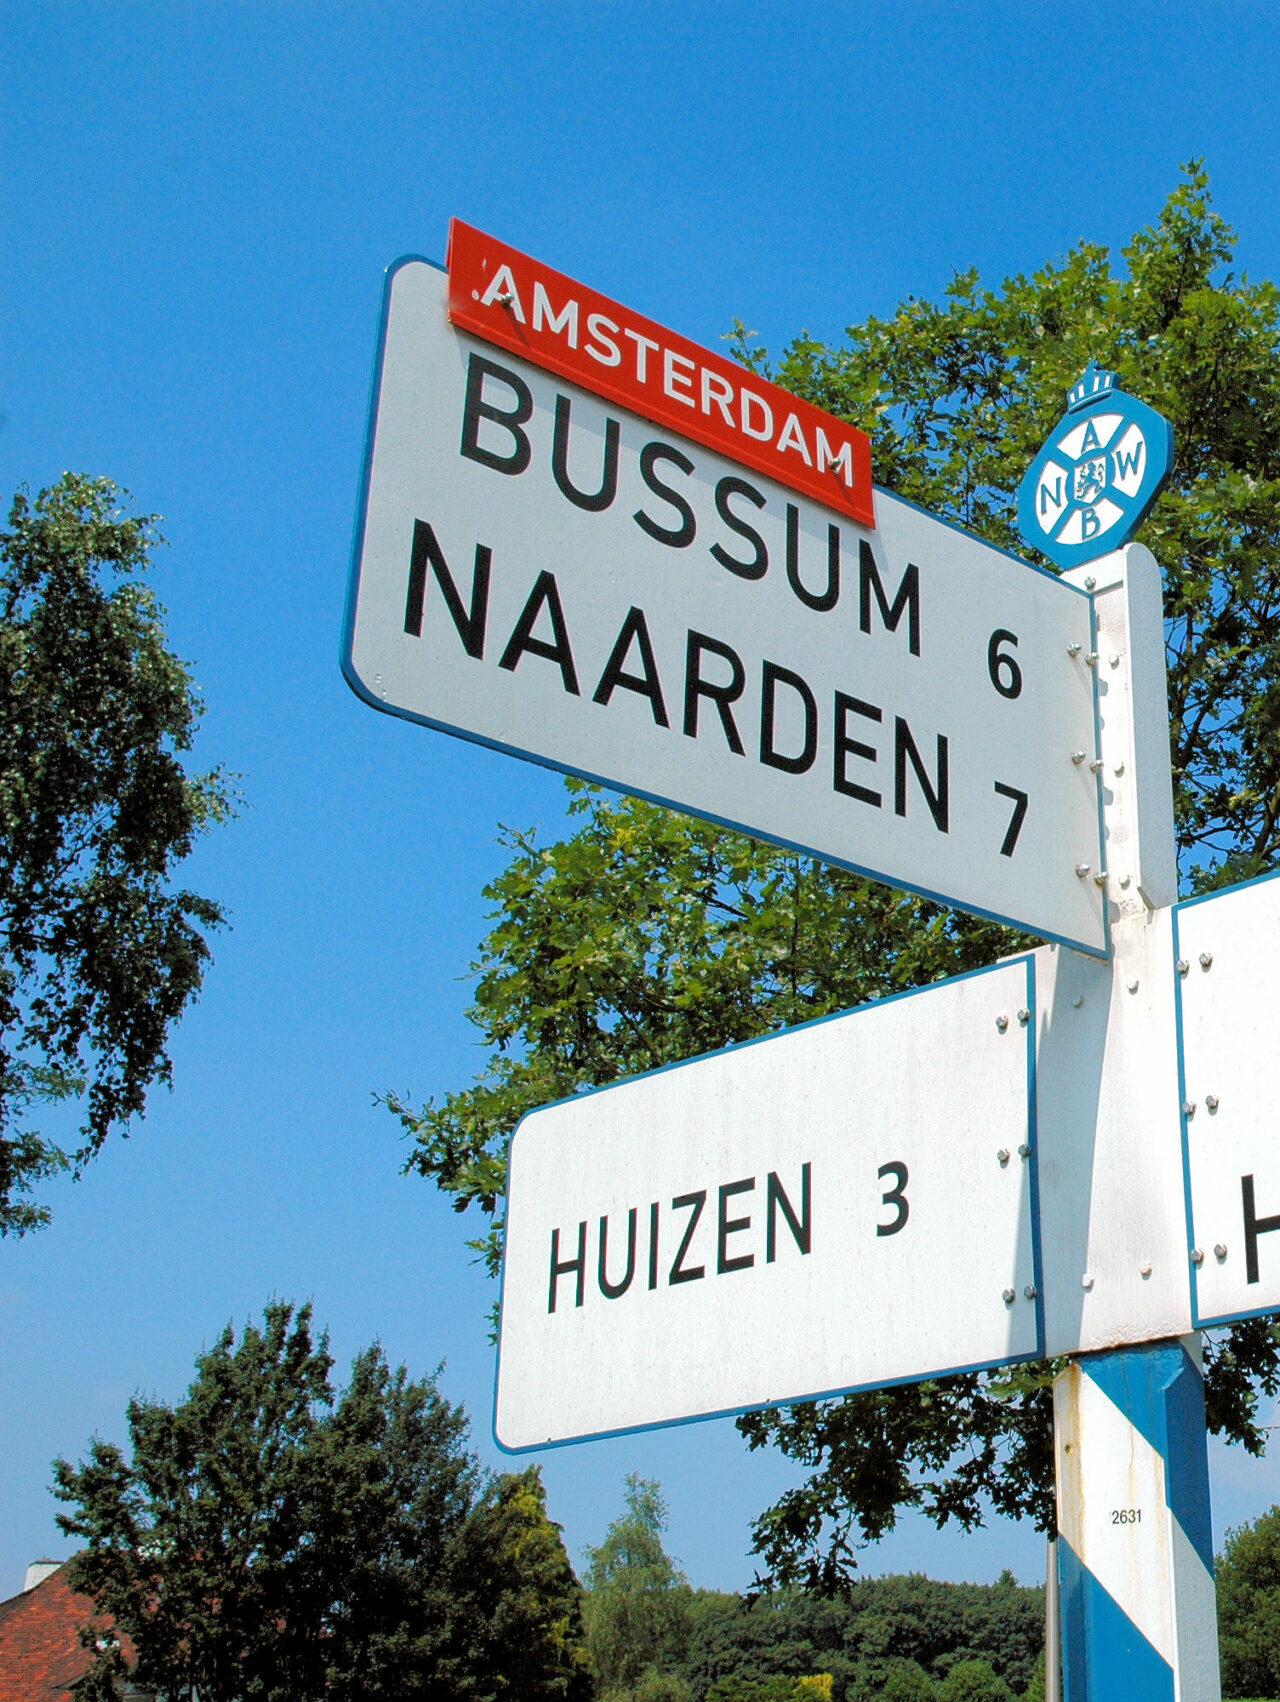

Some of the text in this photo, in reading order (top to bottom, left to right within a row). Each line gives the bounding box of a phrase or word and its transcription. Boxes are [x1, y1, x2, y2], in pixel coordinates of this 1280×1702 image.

[481, 264, 853, 488] AMSTERDAM
[460, 351, 1023, 700] BUSSUM 6
[403, 518, 1029, 858] NAARDEN 7
[548, 1161, 909, 1314] HUIZEN 3
[1111, 1509, 1143, 1525] 2631
